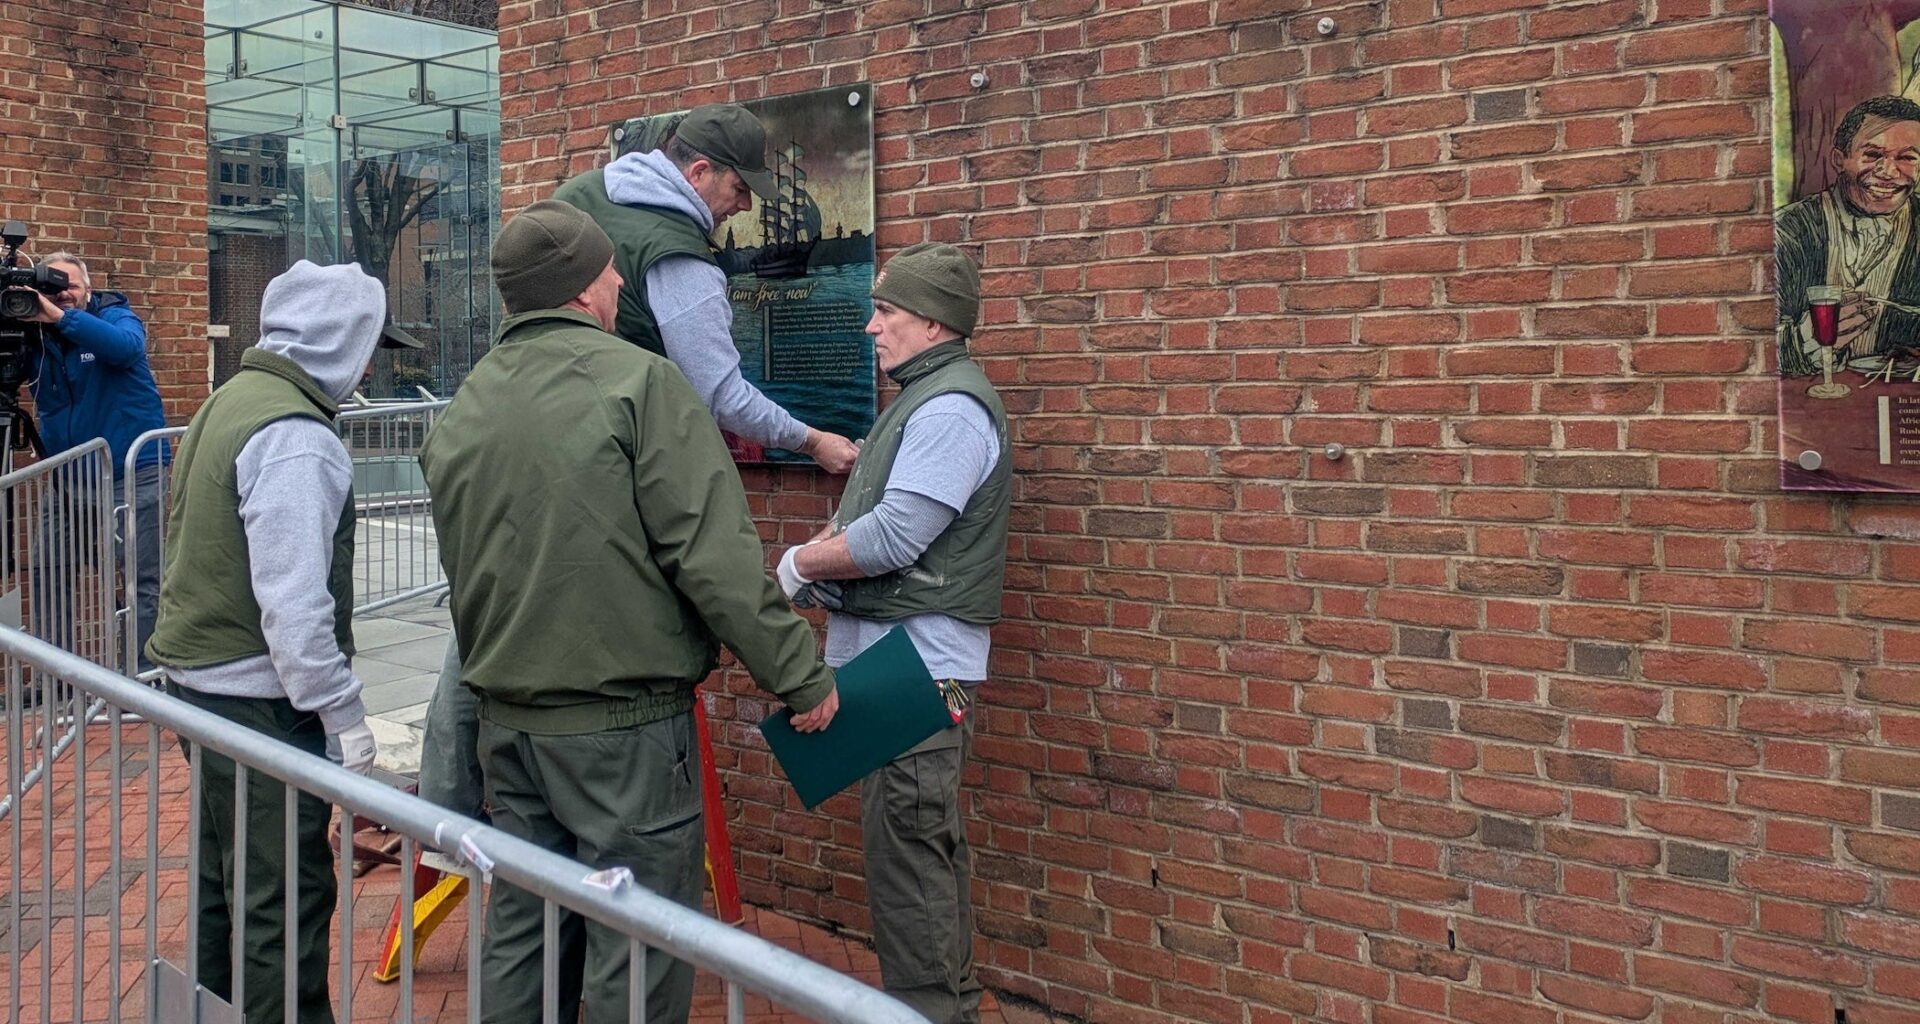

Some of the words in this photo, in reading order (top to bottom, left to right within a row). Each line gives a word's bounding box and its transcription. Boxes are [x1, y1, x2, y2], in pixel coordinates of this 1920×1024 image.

[732, 289, 752, 301] am
[752, 281, 780, 311] free
[1898, 396, 1908, 404] In
